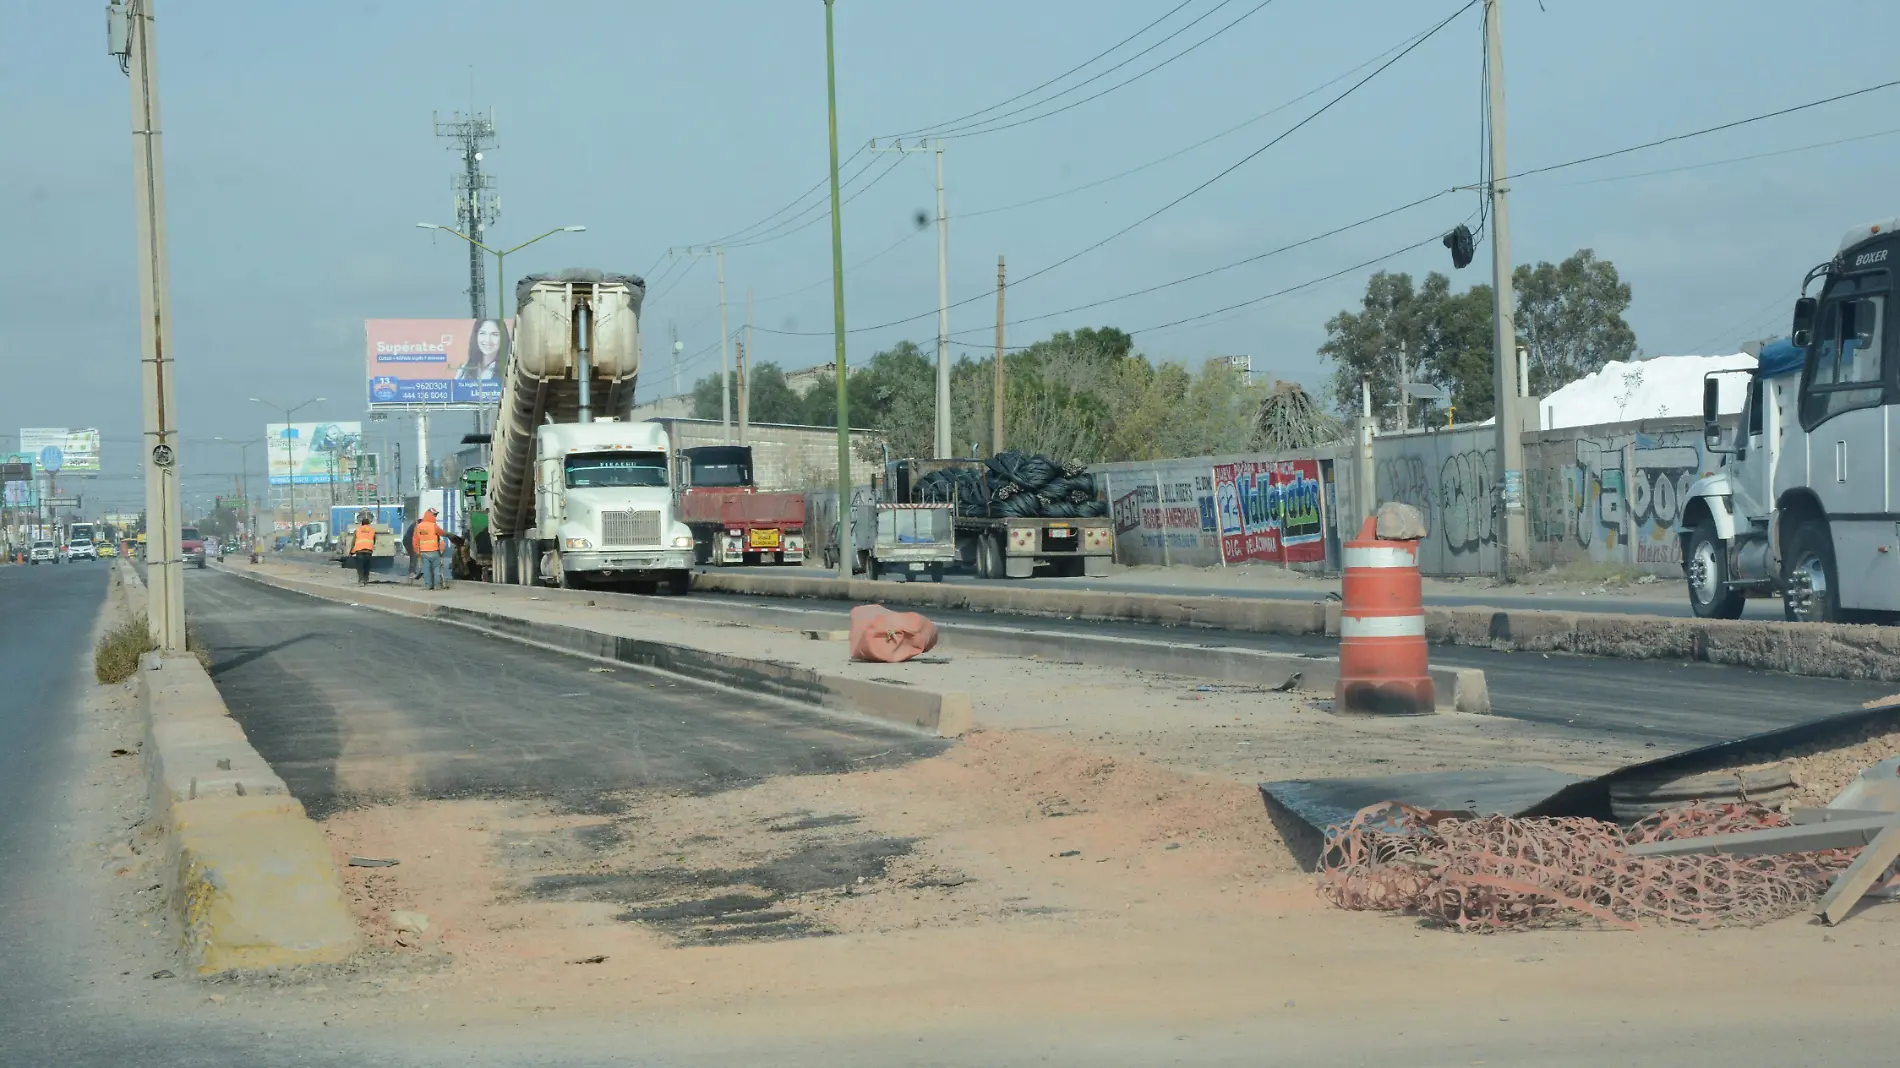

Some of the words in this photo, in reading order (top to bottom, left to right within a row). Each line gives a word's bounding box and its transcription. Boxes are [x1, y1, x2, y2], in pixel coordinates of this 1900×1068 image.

[1855, 249, 1888, 266] BOXER
[377, 341, 444, 355] Supératec
[1235, 470, 1322, 541] Vallenatos
